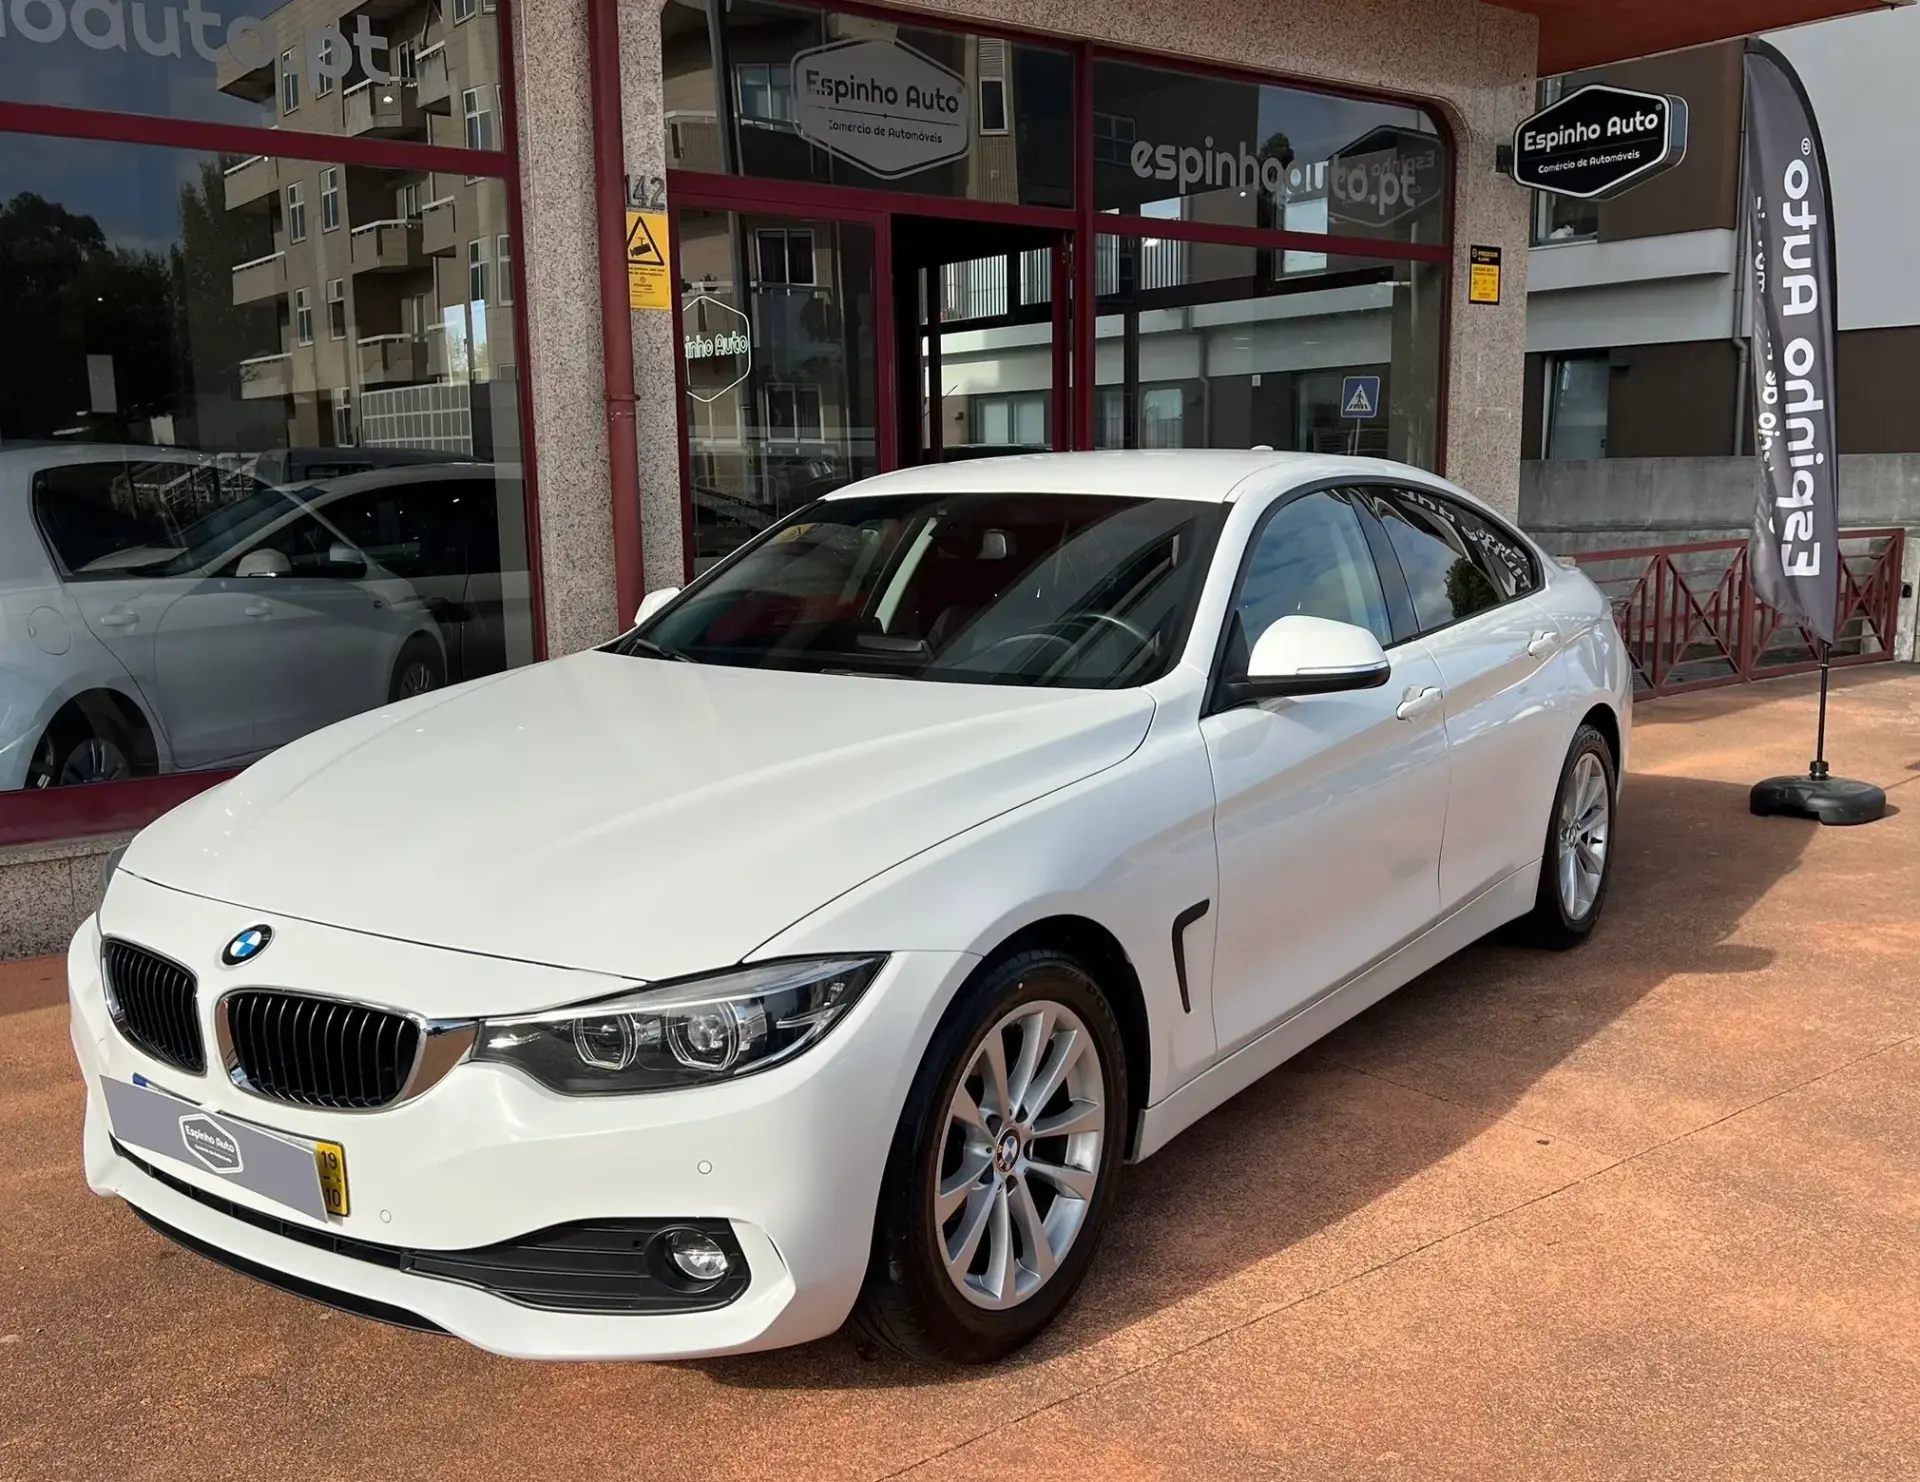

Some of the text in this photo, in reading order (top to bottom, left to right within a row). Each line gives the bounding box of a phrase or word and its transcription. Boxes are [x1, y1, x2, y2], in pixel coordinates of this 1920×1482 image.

[0, 0, 391, 94] oauto.pt
[806, 69, 959, 114] Espinho Auto
[874, 125, 885, 137] de
[1524, 111, 1659, 153] Espinho Auto
[1577, 158, 1588, 167] de
[1589, 149, 1640, 166] Automóveis
[625, 174, 665, 210] 142
[715, 330, 748, 356] Auto
[321, 1150, 338, 1170] 19
[325, 1187, 341, 1207] 10
